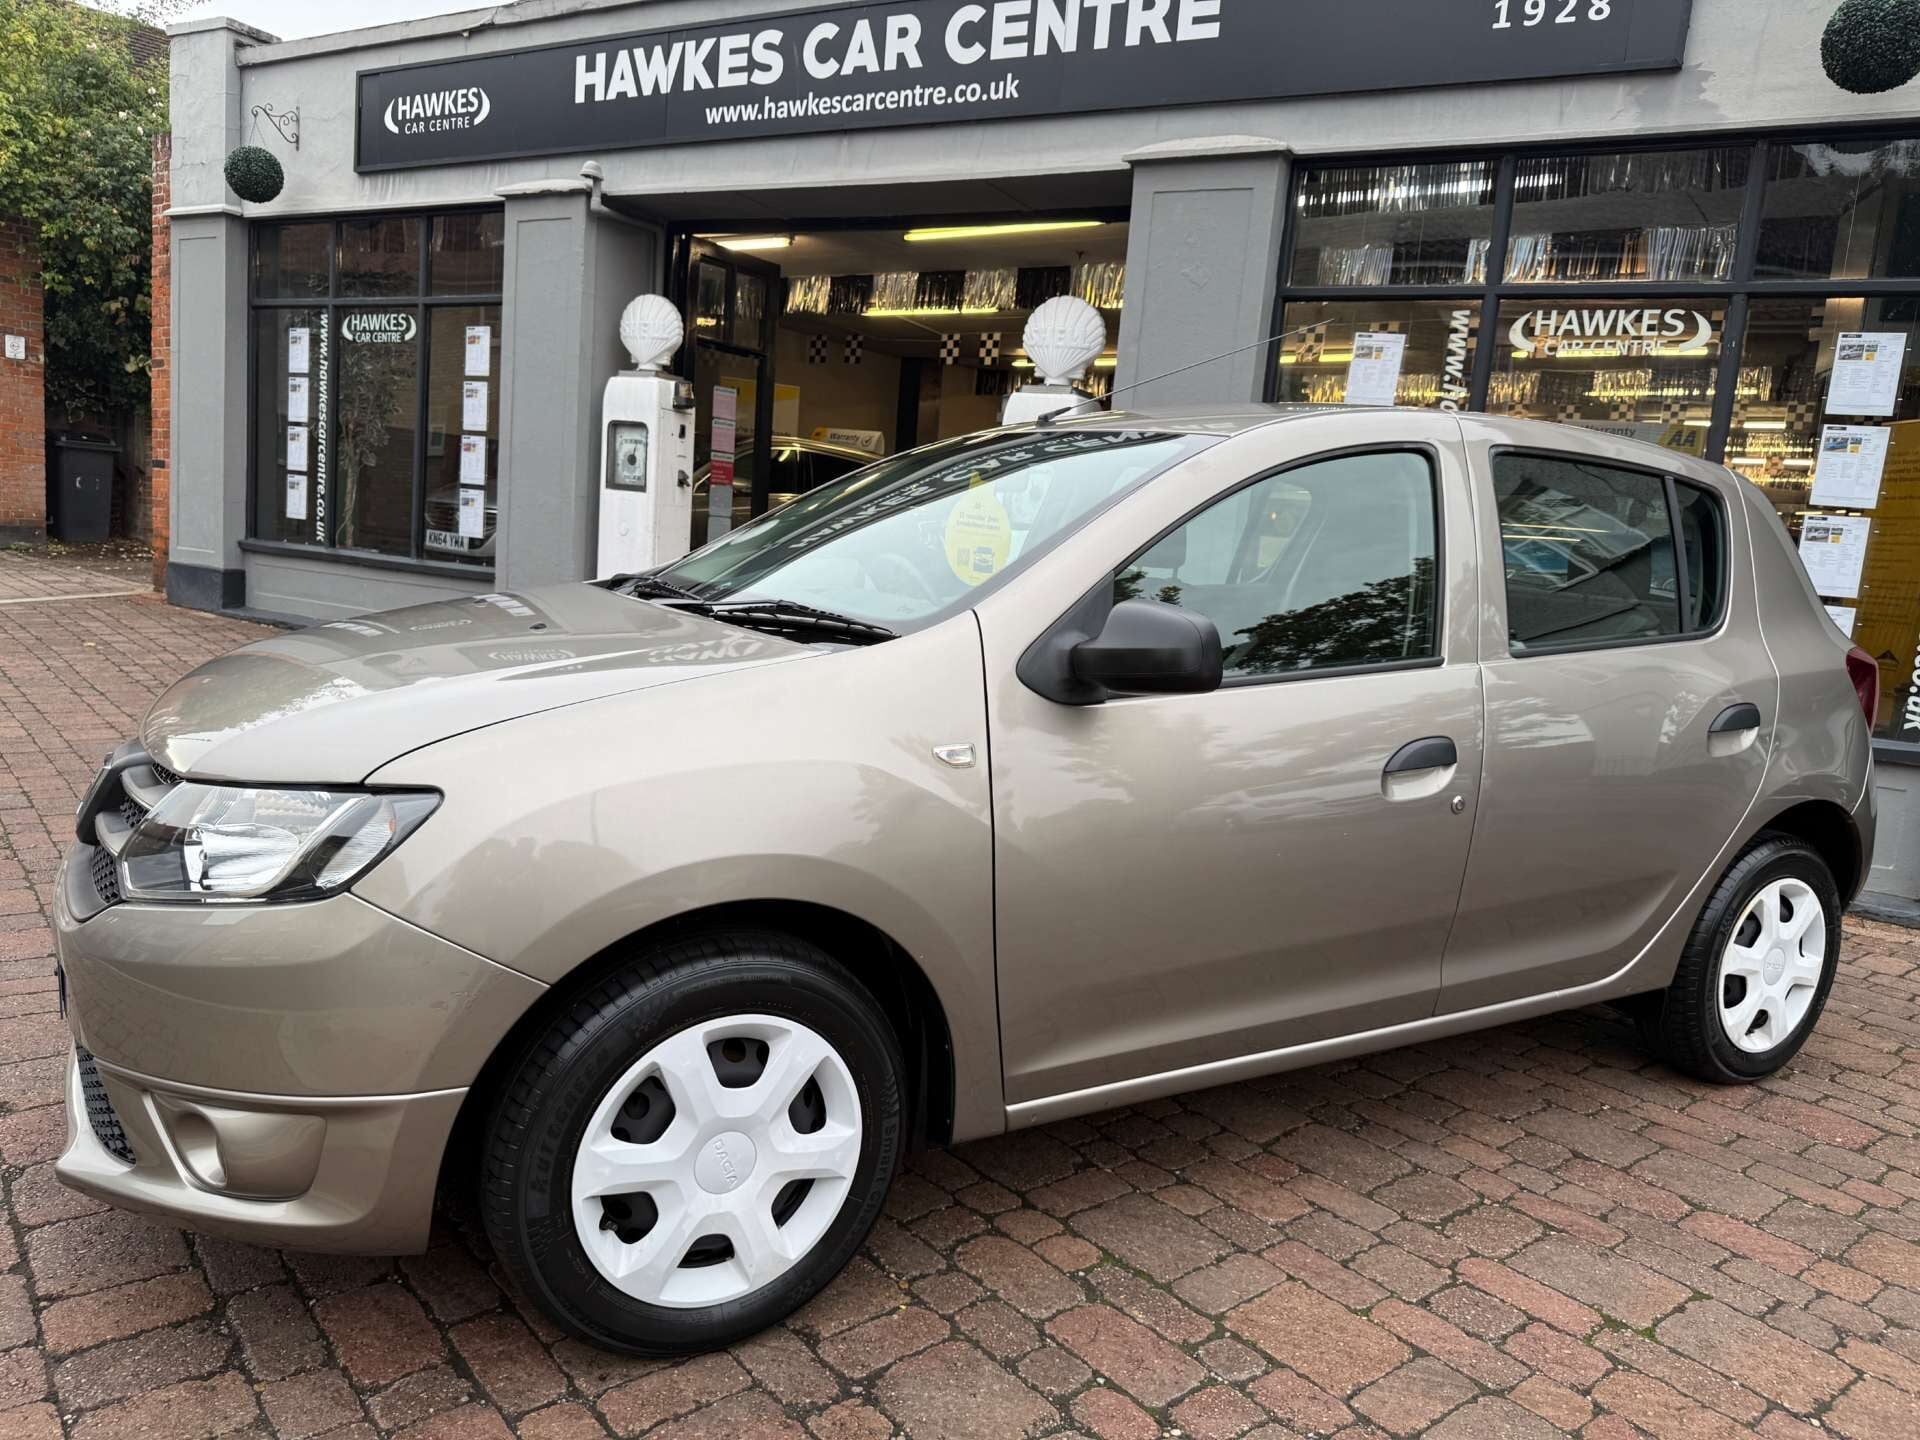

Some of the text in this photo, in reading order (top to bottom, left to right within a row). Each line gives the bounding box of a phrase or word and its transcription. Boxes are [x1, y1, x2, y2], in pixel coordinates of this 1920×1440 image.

[1491, 0, 1612, 29] 1928
[574, 0, 1222, 104] HAWKES CAR CENTRE
[397, 86, 480, 121] HAWKES
[704, 72, 1020, 125] www.hawkescarcentre.co.uk
[404, 115, 471, 135] CAR CENTRE
[350, 312, 408, 332] HAWKES
[1533, 308, 1686, 337] HAWKES
[354, 331, 402, 343] CAR CENTRE
[1543, 338, 1667, 356] CAR CENTRE
[316, 313, 329, 542] www.hawkescarcentre.co.uk
[1667, 429, 1698, 448] AA
[713, 1138, 738, 1188] DACIA
